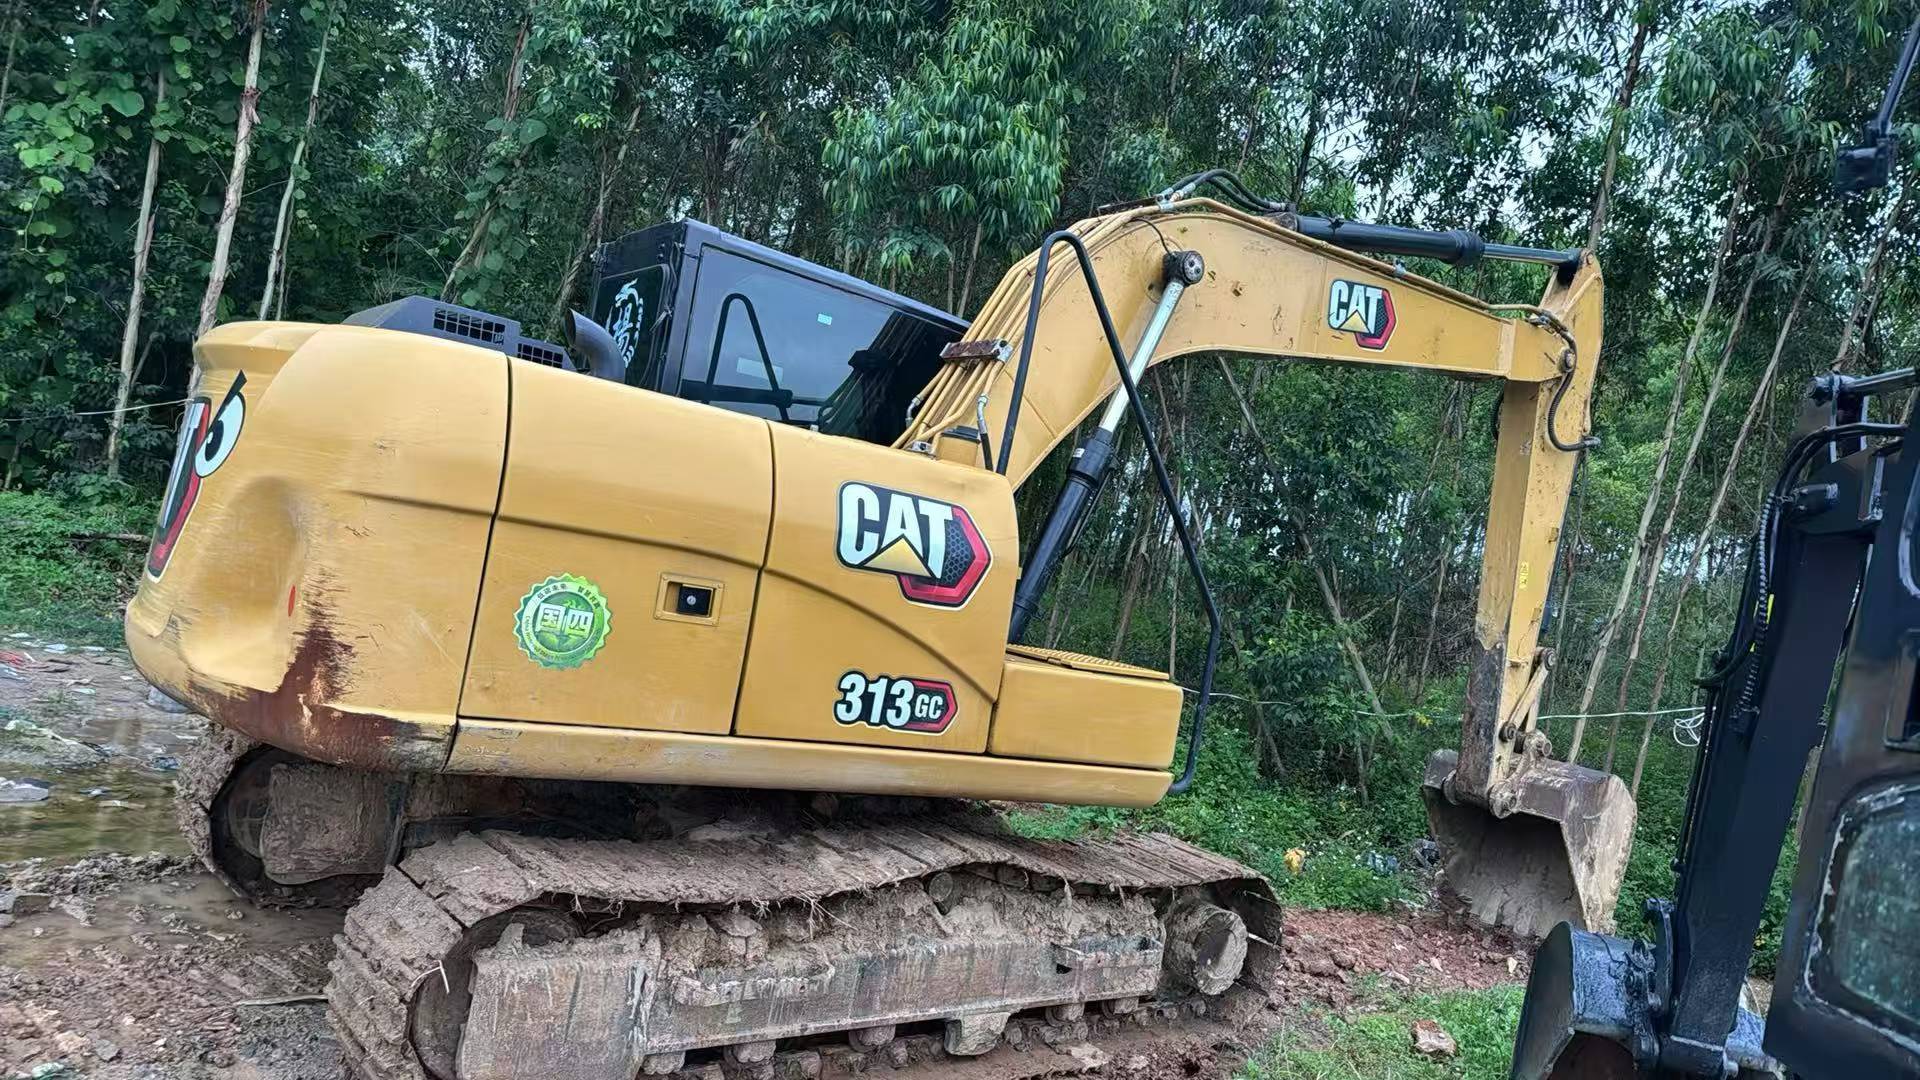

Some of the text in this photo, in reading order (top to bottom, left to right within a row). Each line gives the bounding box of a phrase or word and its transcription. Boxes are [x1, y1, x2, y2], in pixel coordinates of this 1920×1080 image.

[1329, 280, 1383, 335] CAT
[839, 483, 954, 579] CAT
[535, 602, 594, 638] 国四
[836, 673, 943, 727] 313 GC
